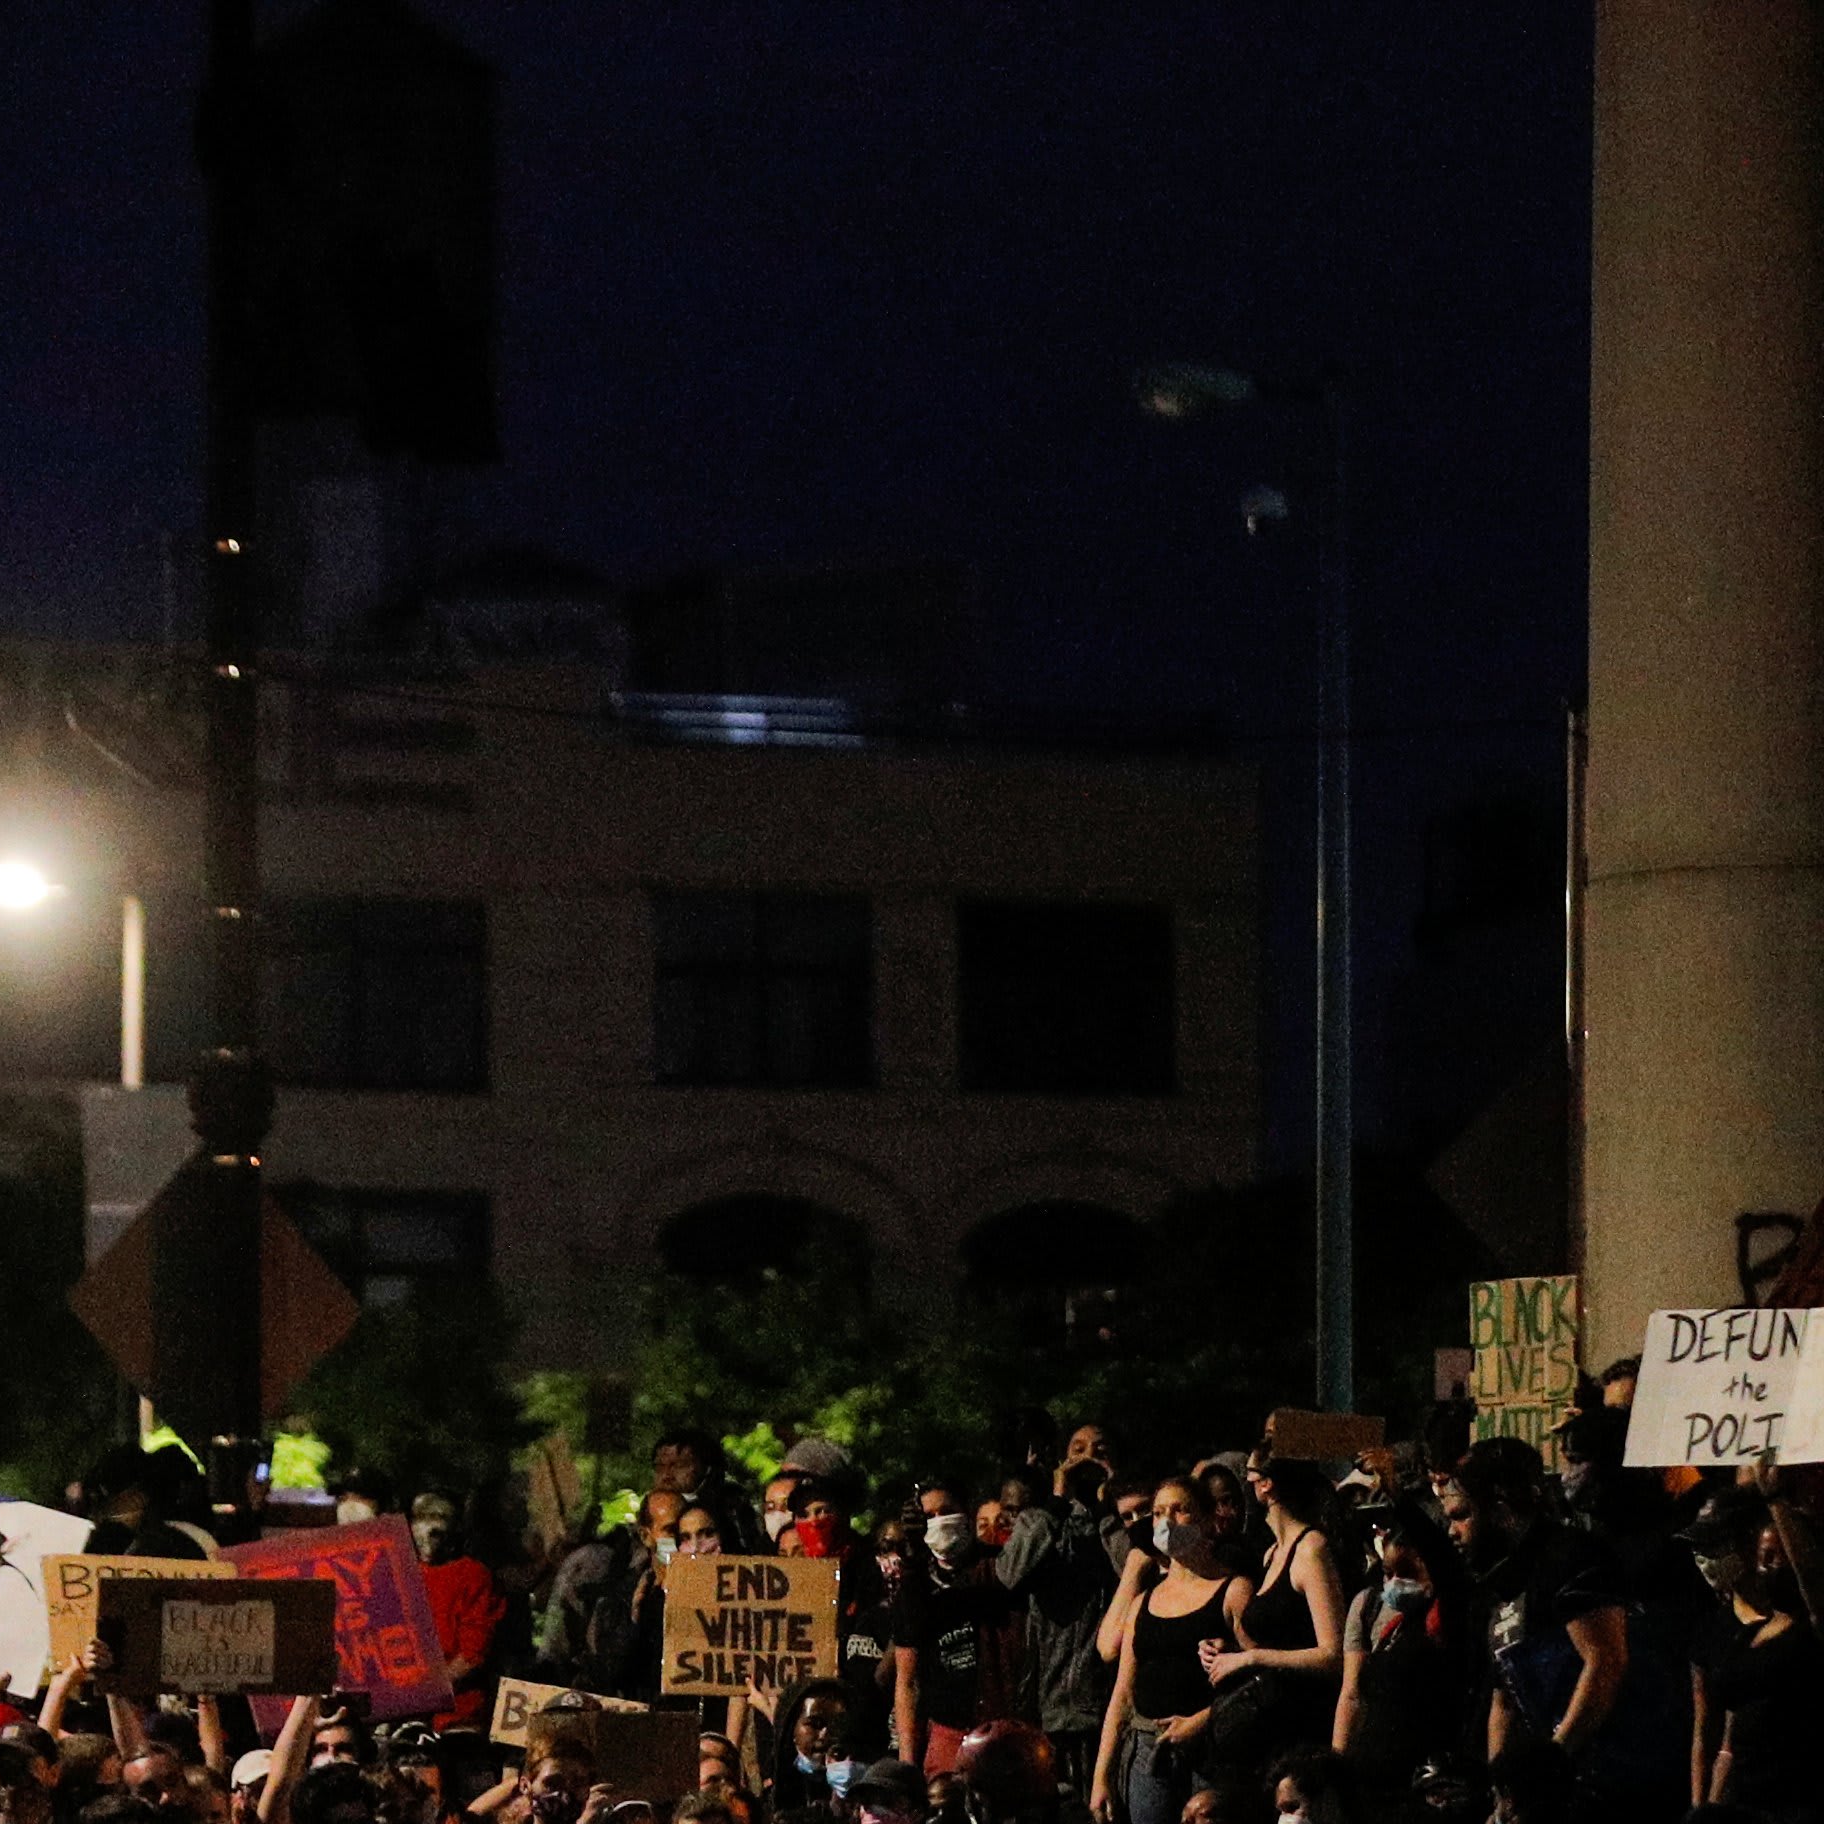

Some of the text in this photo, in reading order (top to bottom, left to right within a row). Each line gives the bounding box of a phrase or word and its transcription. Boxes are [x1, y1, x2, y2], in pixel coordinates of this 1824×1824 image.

[1473, 1279, 1579, 1349] BLACK
[1477, 1343, 1575, 1398] LIVES
[1722, 1371, 1768, 1402] the
[1684, 1411, 1786, 1461] POLI
[717, 1564, 790, 1602] END
[168, 1605, 265, 1636] BLACK
[695, 1608, 813, 1652] WHITE
[202, 1633, 230, 1653] IS
[670, 1650, 817, 1691] SILENCE
